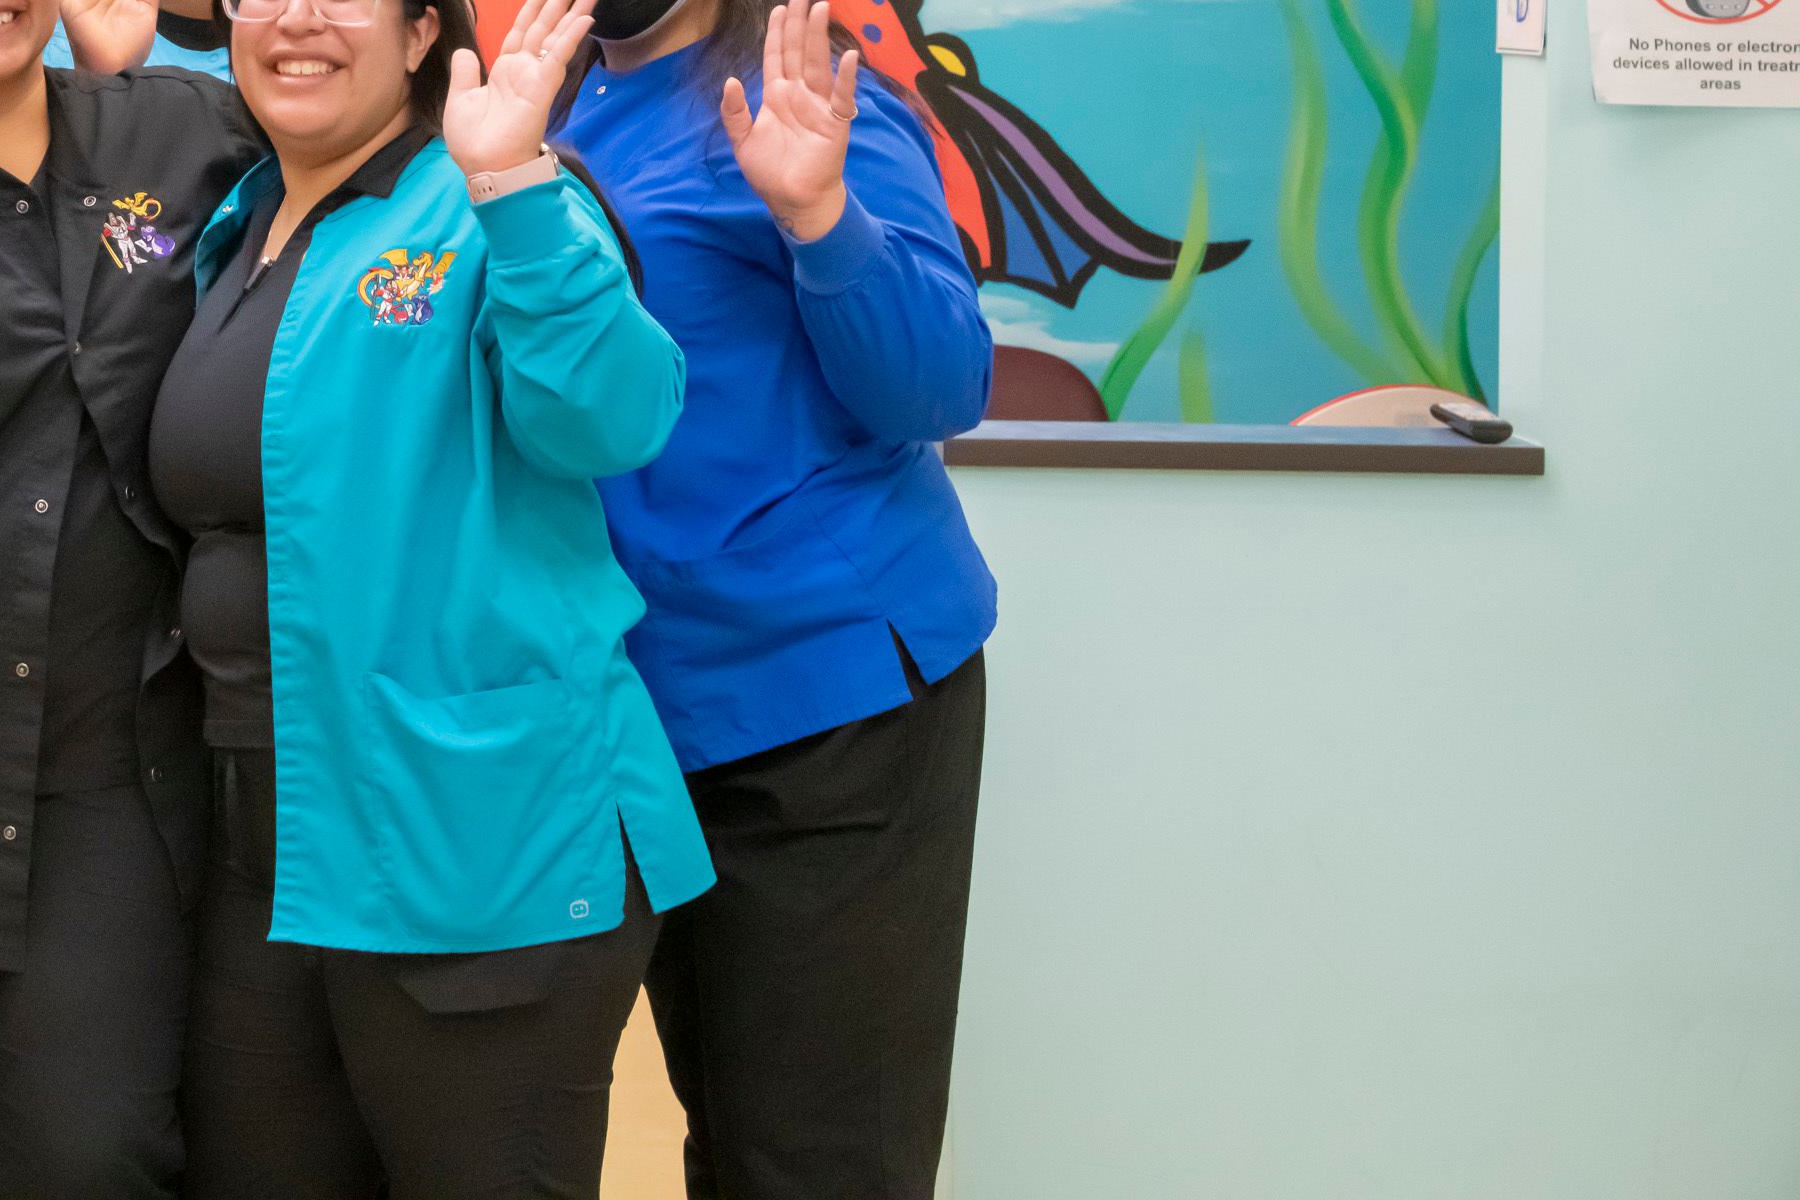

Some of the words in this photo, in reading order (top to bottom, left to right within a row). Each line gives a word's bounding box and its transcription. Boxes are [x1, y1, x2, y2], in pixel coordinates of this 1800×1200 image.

[1629, 38, 1649, 51] No
[1654, 39, 1711, 52] Phones
[1716, 42, 1733, 52] or
[1613, 57, 1670, 70] devices
[1675, 58, 1733, 71] allowed
[1738, 58, 1752, 71] in
[1700, 79, 1741, 90] areas
